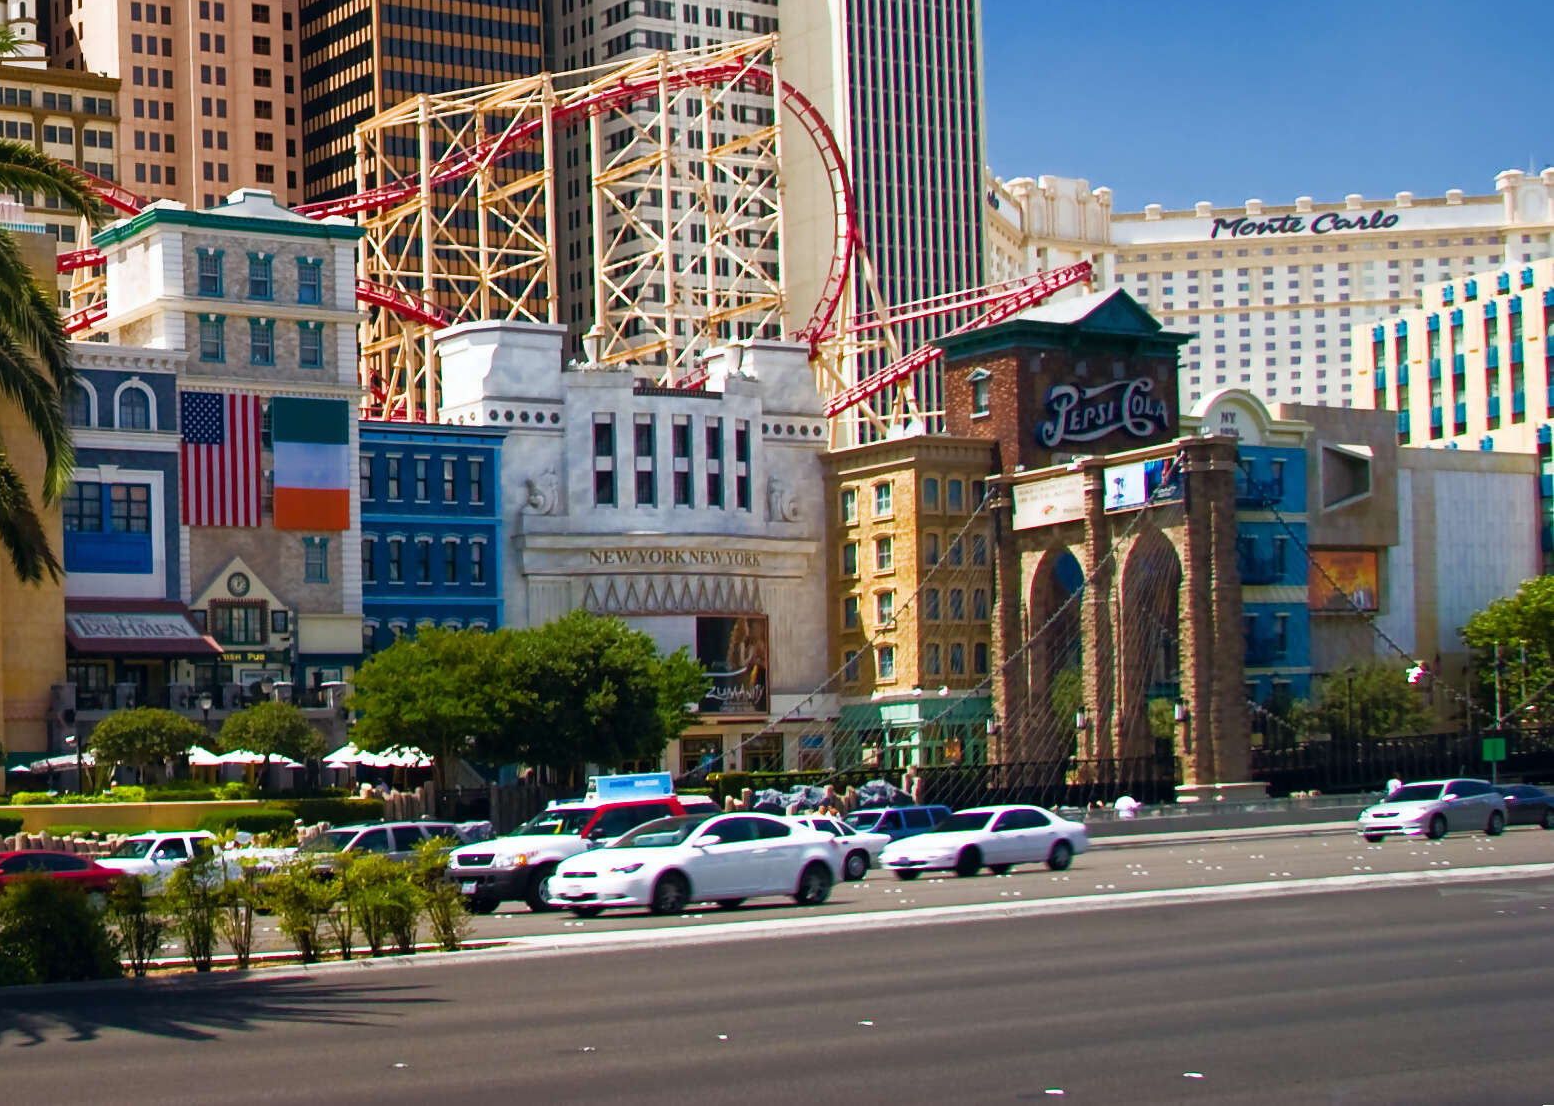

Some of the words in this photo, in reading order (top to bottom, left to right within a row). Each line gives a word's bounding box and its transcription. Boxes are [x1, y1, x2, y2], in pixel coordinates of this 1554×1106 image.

[1211, 214, 1306, 239] Monte
[1311, 209, 1400, 235] Carlo
[589, 550, 632, 564] NEW
[637, 550, 689, 564] YORK
[689, 550, 723, 565] NEW
[726, 552, 762, 567] YORK
